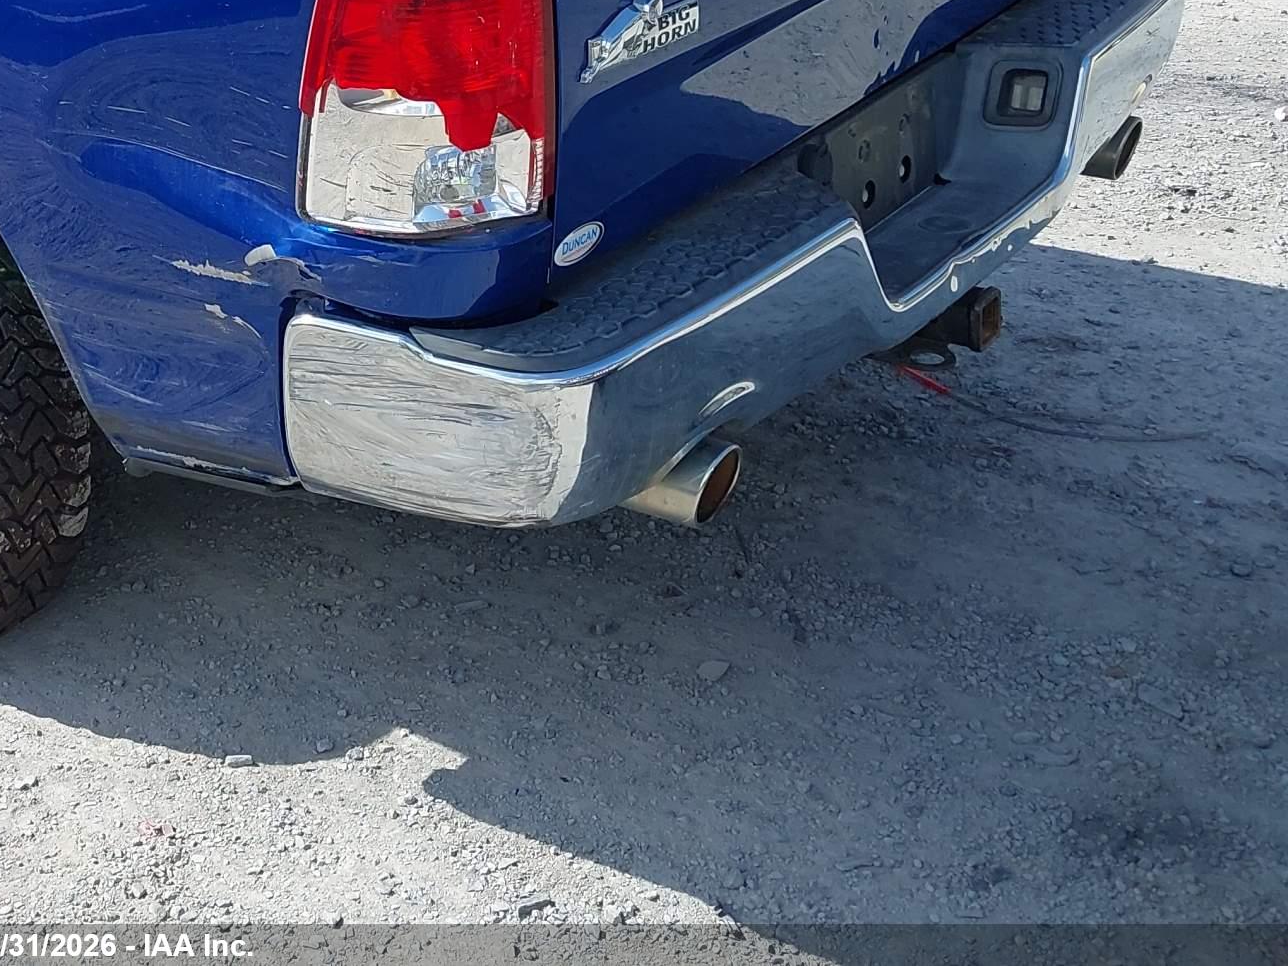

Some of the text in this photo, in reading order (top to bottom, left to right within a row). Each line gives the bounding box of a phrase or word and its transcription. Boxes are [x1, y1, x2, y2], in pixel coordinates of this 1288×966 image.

[657, 5, 691, 32] BIG
[643, 19, 697, 54] HORN
[561, 226, 598, 256] DUNCAN
